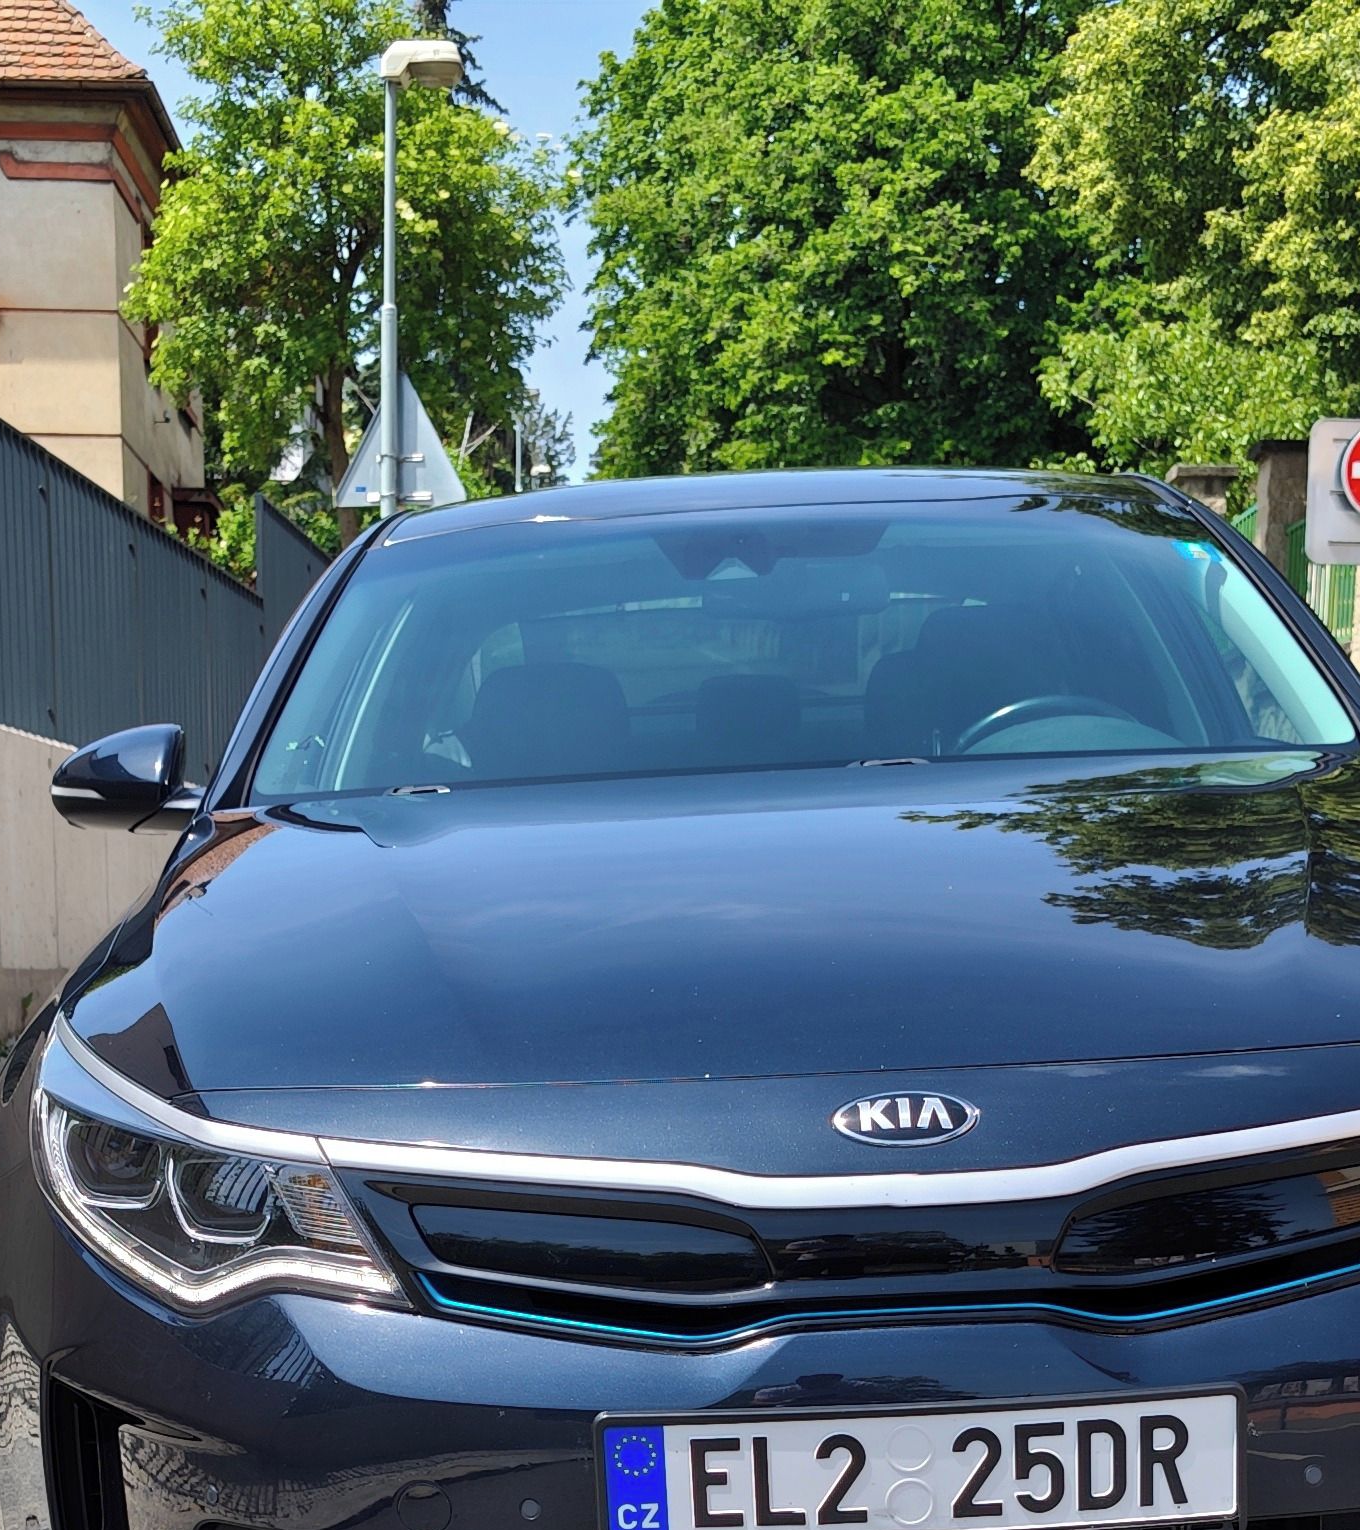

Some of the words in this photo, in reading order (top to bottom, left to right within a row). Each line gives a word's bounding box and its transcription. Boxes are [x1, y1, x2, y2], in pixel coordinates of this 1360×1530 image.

[857, 1098, 953, 1131] KIA
[690, 1433, 868, 1528] EL2
[952, 1414, 1189, 1518] 25DR
[617, 1503, 660, 1530] CZ
